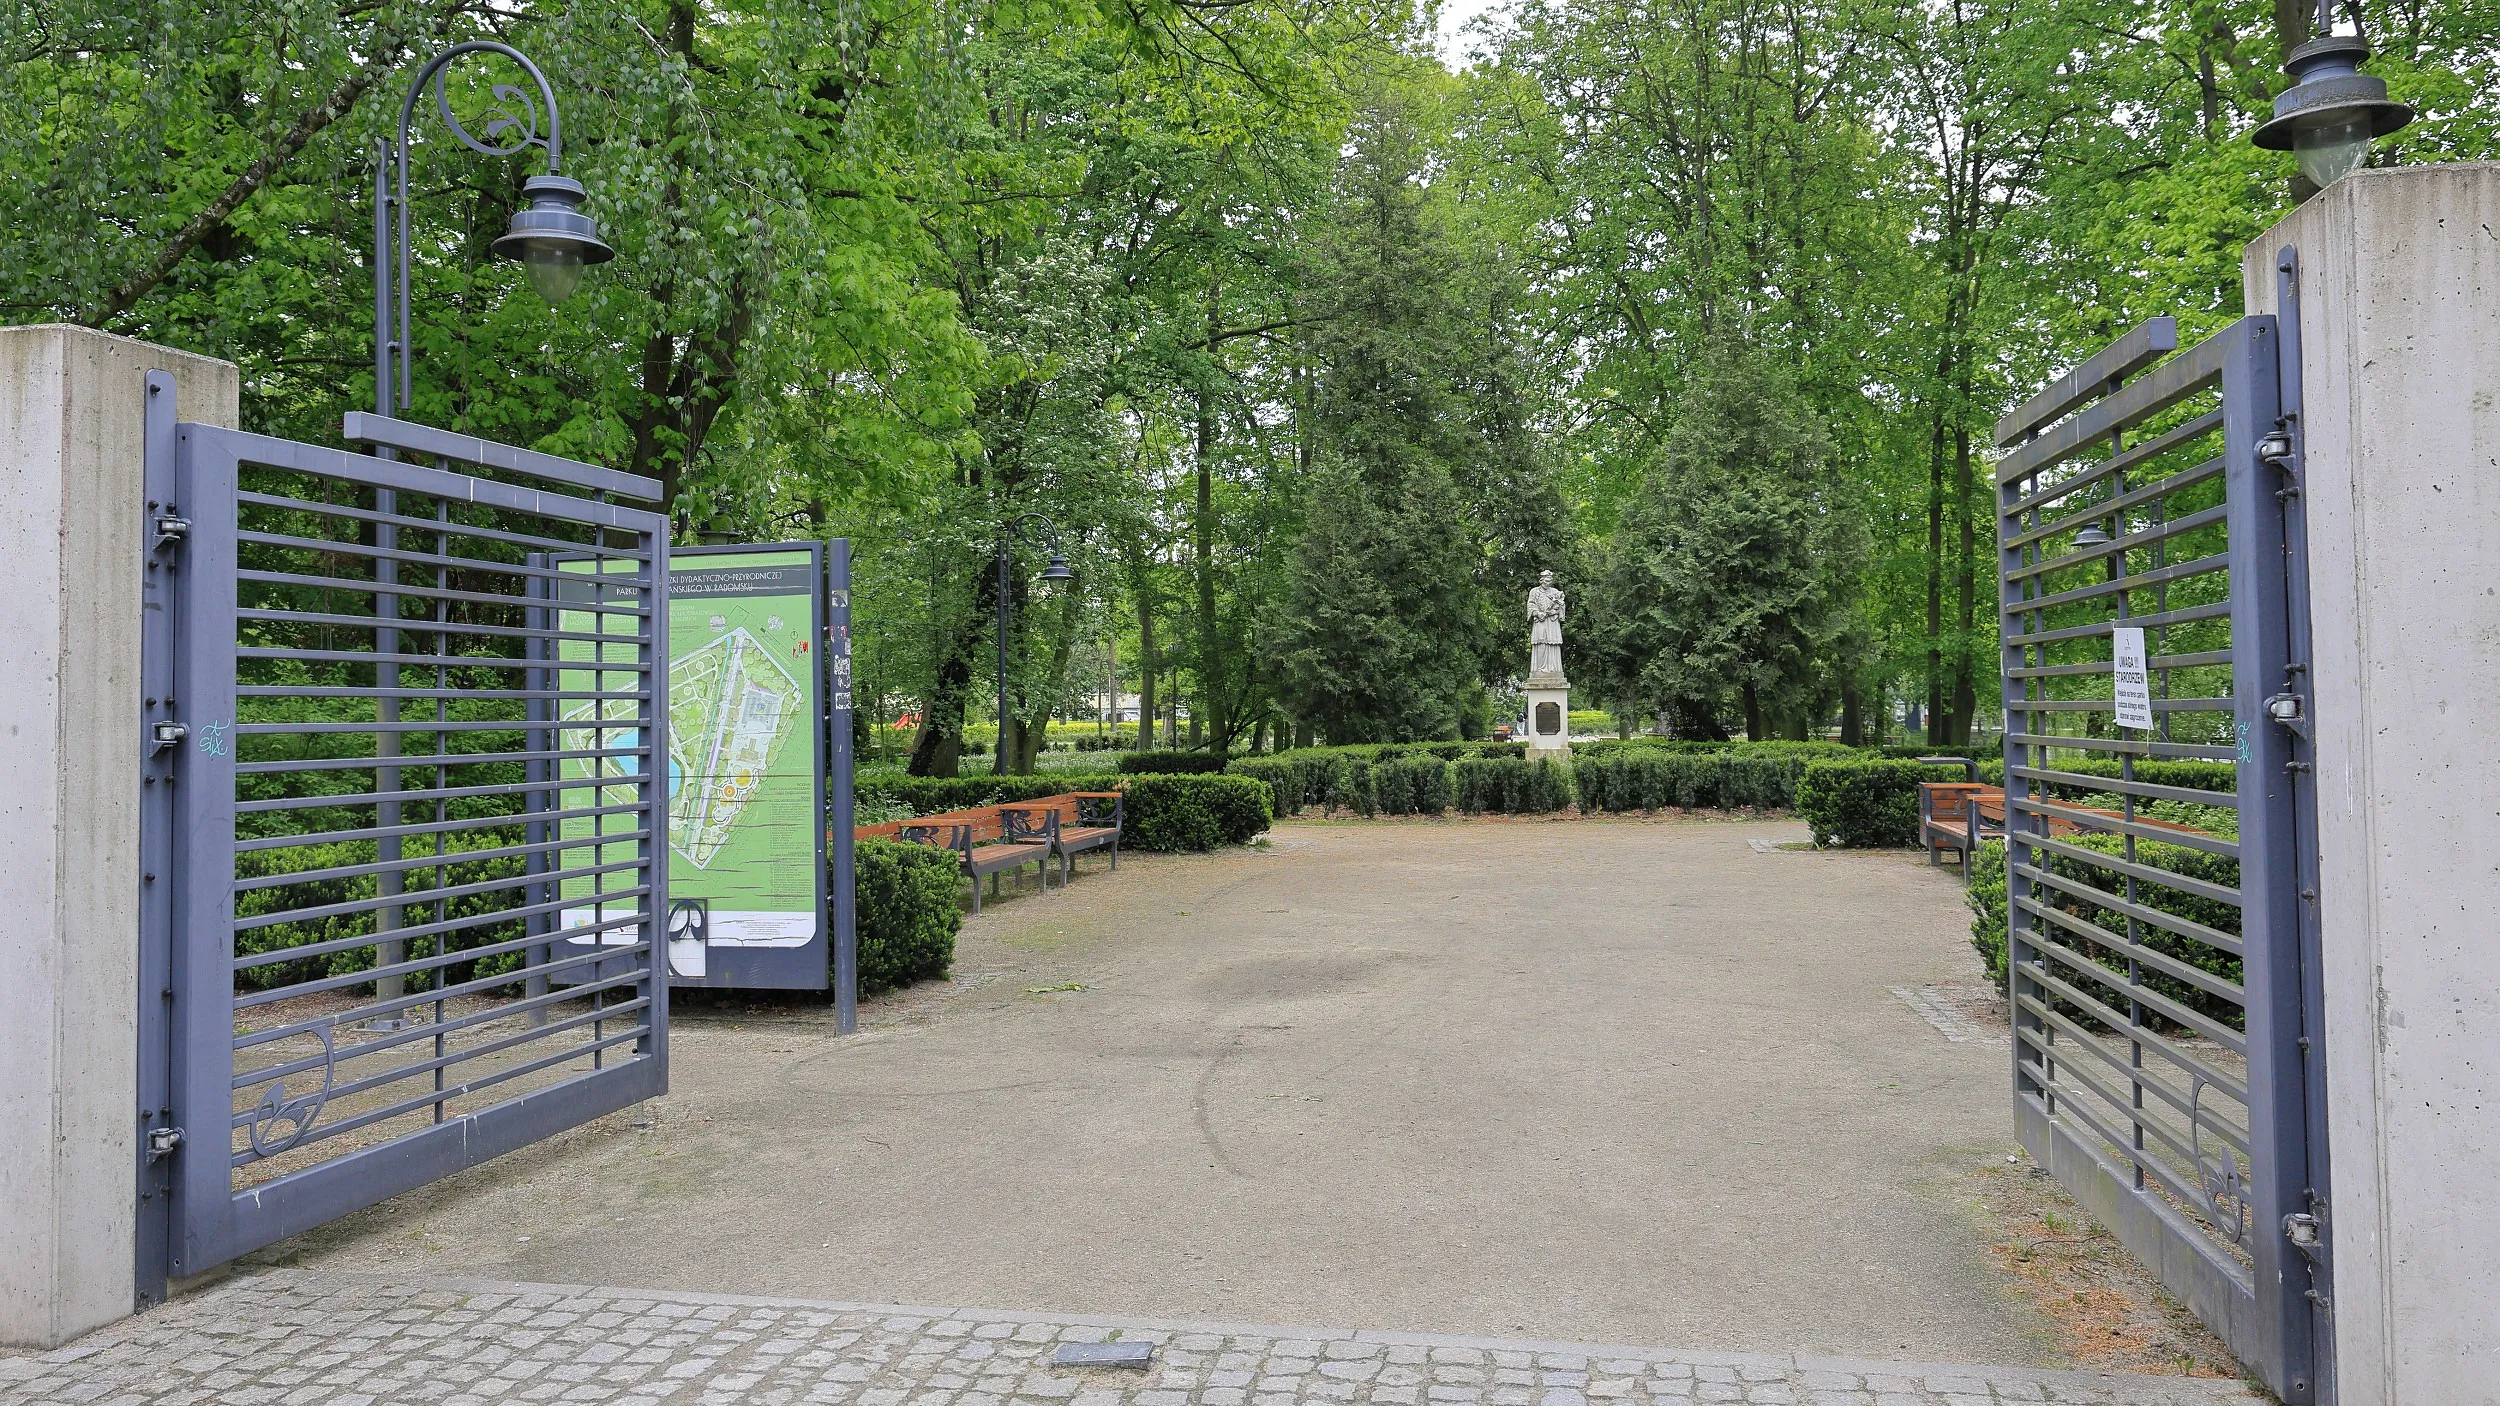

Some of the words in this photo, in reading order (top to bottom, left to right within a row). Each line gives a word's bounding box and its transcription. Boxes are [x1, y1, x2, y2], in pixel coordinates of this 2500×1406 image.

[681, 571, 782, 584] DYDAKTYCZNO-PRZYRODNICZEJ
[616, 587, 638, 596] PARKU
[668, 583, 702, 594] AŃSKIEGO
[704, 584, 712, 593] W
[713, 582, 753, 593] RADOMSKU
[2118, 656, 2134, 668] UWAGA
[2115, 671, 2145, 684] STARODRZEW
